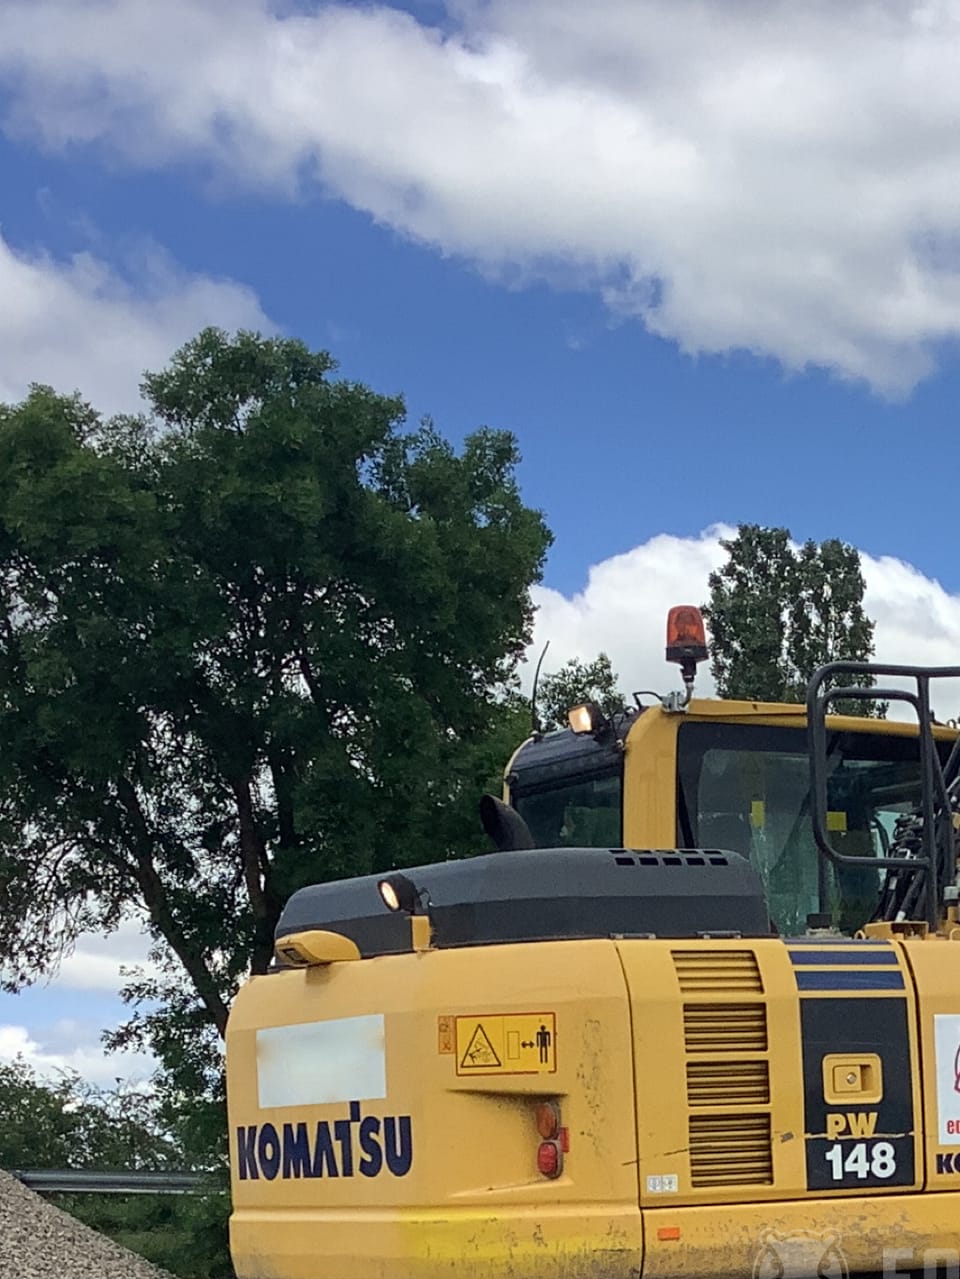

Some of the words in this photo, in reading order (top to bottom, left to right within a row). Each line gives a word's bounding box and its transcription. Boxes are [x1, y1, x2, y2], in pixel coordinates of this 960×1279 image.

[237, 1100, 412, 1180] KOMATSU
[826, 1112, 878, 1140] PW
[825, 1142, 896, 1180] 148
